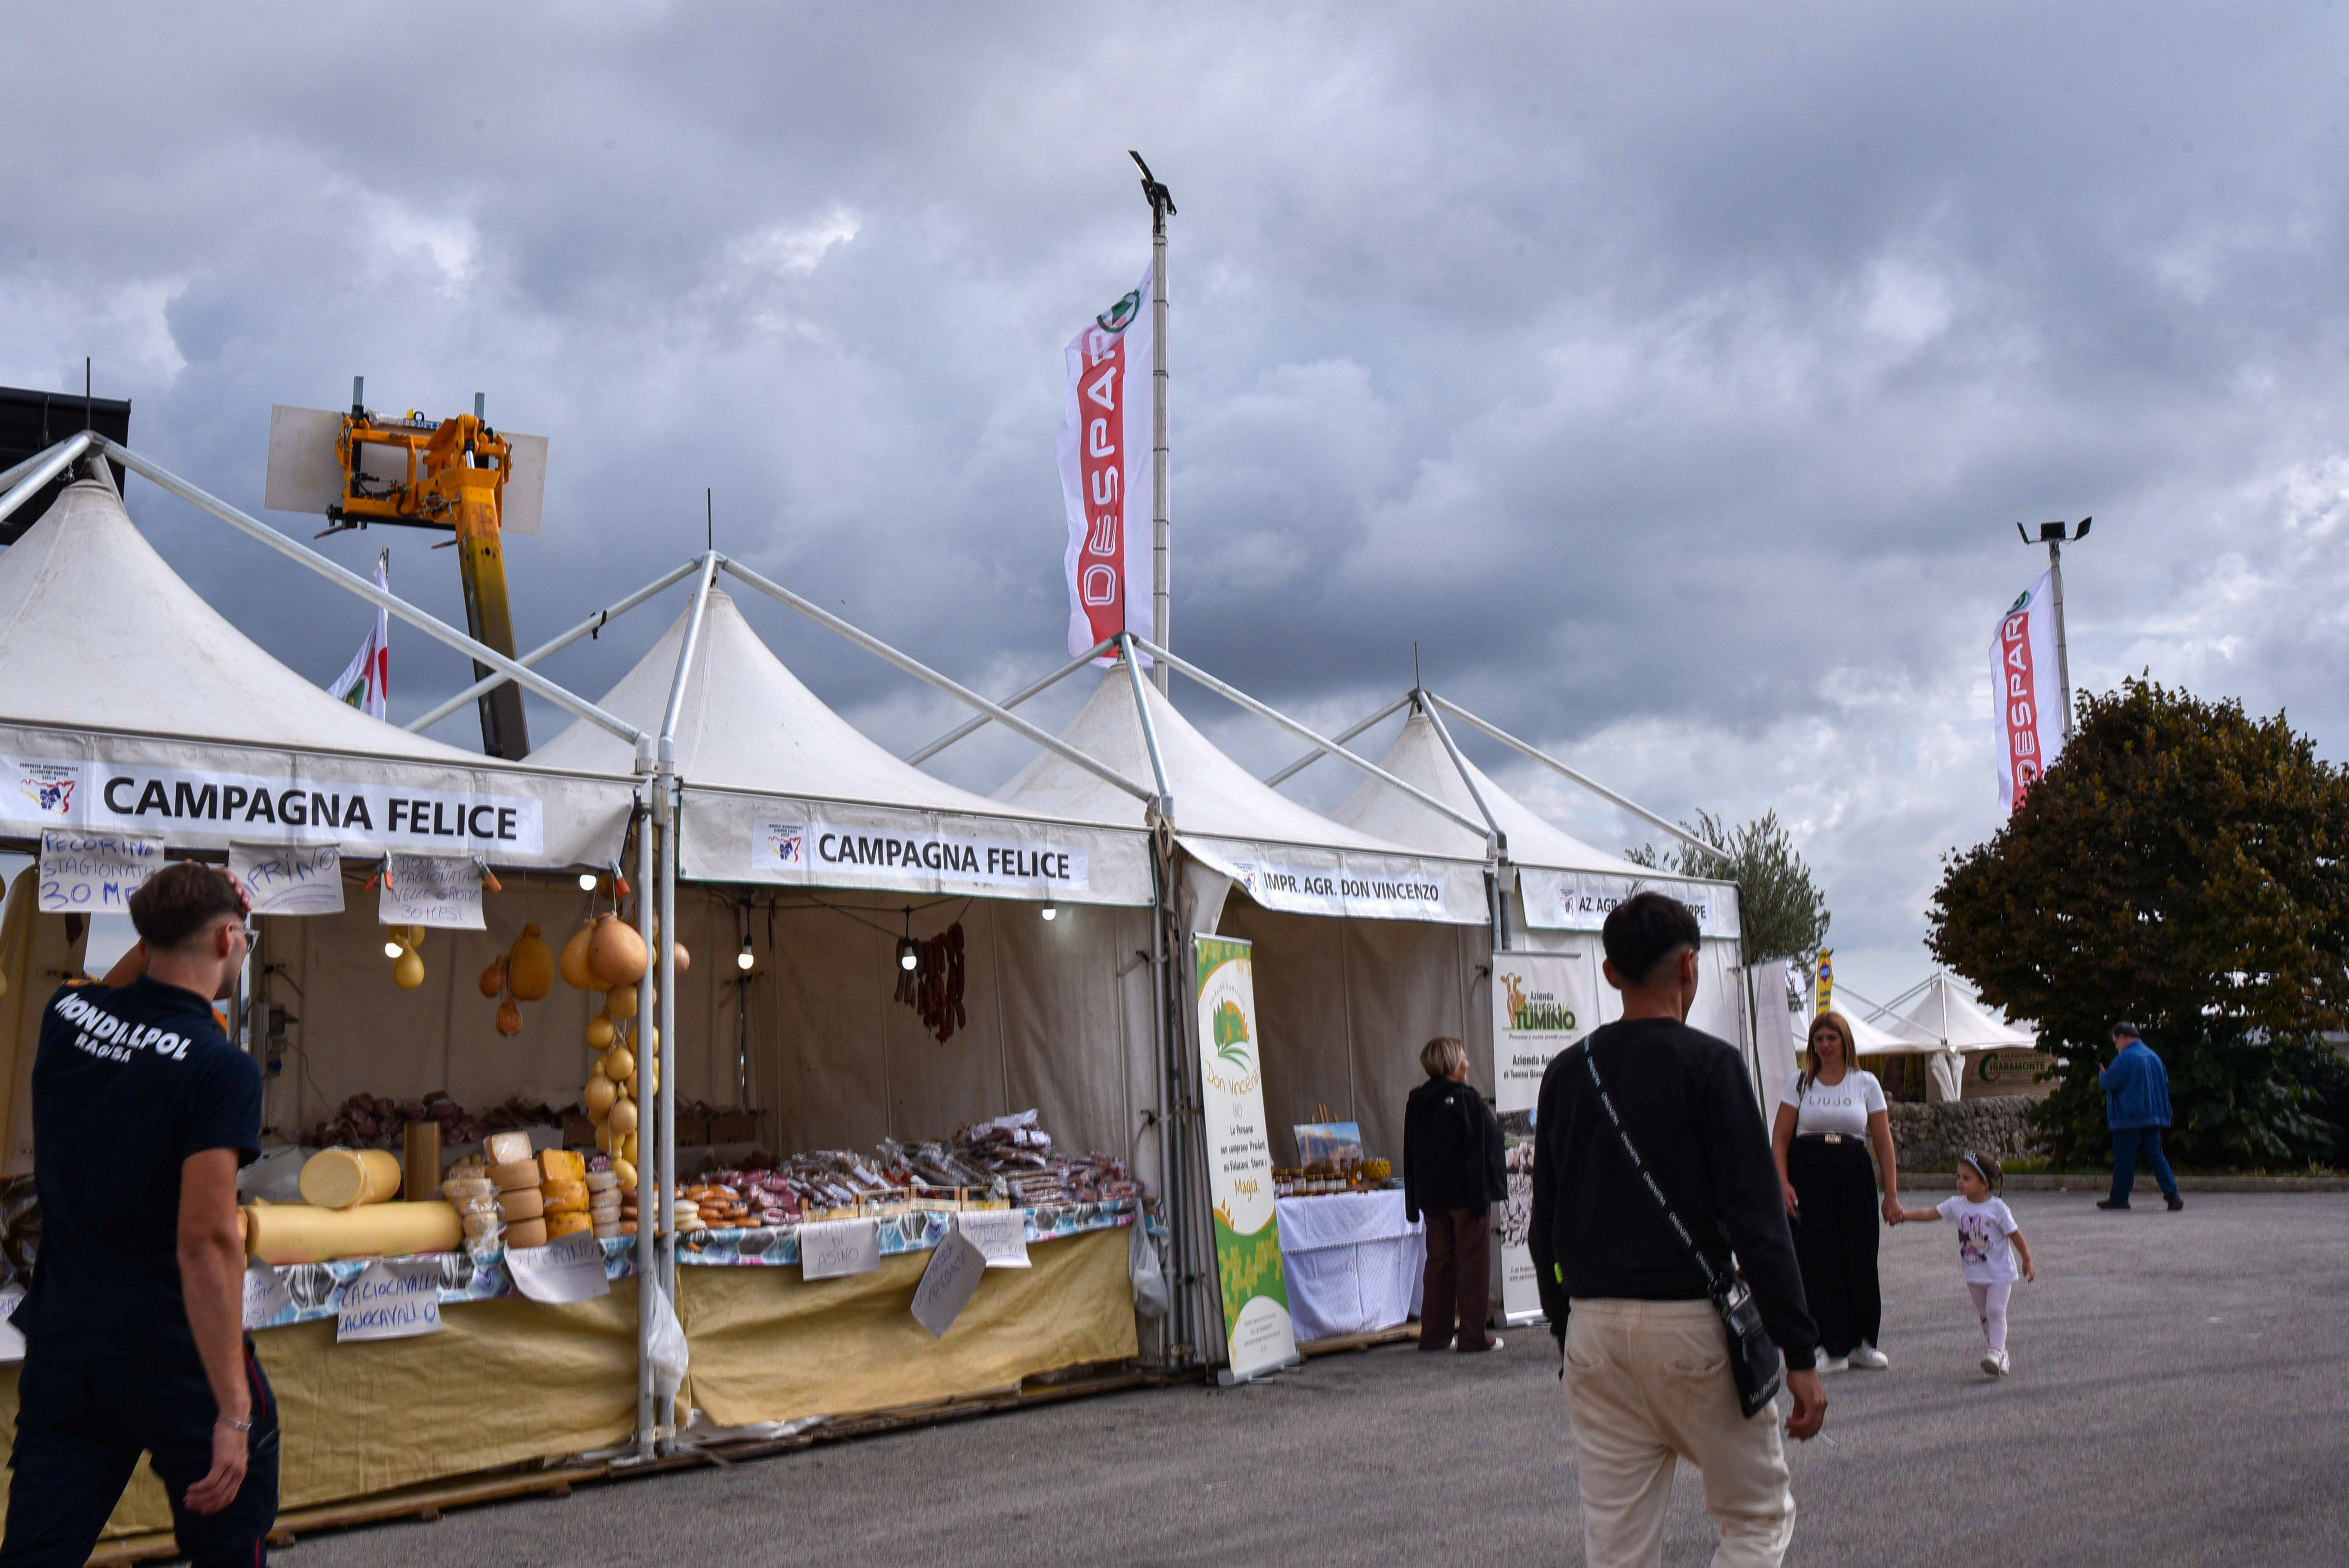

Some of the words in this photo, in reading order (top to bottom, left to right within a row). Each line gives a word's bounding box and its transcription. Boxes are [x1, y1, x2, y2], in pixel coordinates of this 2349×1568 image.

[1083, 328, 1119, 607] DESPAR
[2005, 615, 2038, 787] DESPAR
[104, 776, 373, 831] CAMPAGNA
[388, 798, 517, 840] FELICE
[45, 832, 154, 857] PECORINO
[819, 833, 979, 874] CAMPAGNA
[987, 848, 1070, 880] FELICE
[1263, 871, 1300, 894] IMPR.
[1304, 877, 1337, 896] AGR.
[1341, 879, 1369, 898] DON
[1372, 882, 1439, 901] VINCENZO
[1579, 896, 1594, 912] AZ.
[1523, 1003, 1561, 1011] AGRICOLA
[1530, 990, 1554, 1004] Azienda
[1515, 1011, 1576, 1030] TUMINO
[1512, 1054, 1539, 1066] Azienda
[1205, 1059, 1225, 1093] Don
[1229, 1065, 1260, 1096] Vincenzo
[1503, 1069, 1509, 1080] di
[1510, 1069, 1528, 1080] Tumino
[1530, 1069, 1544, 1079] Giuse
